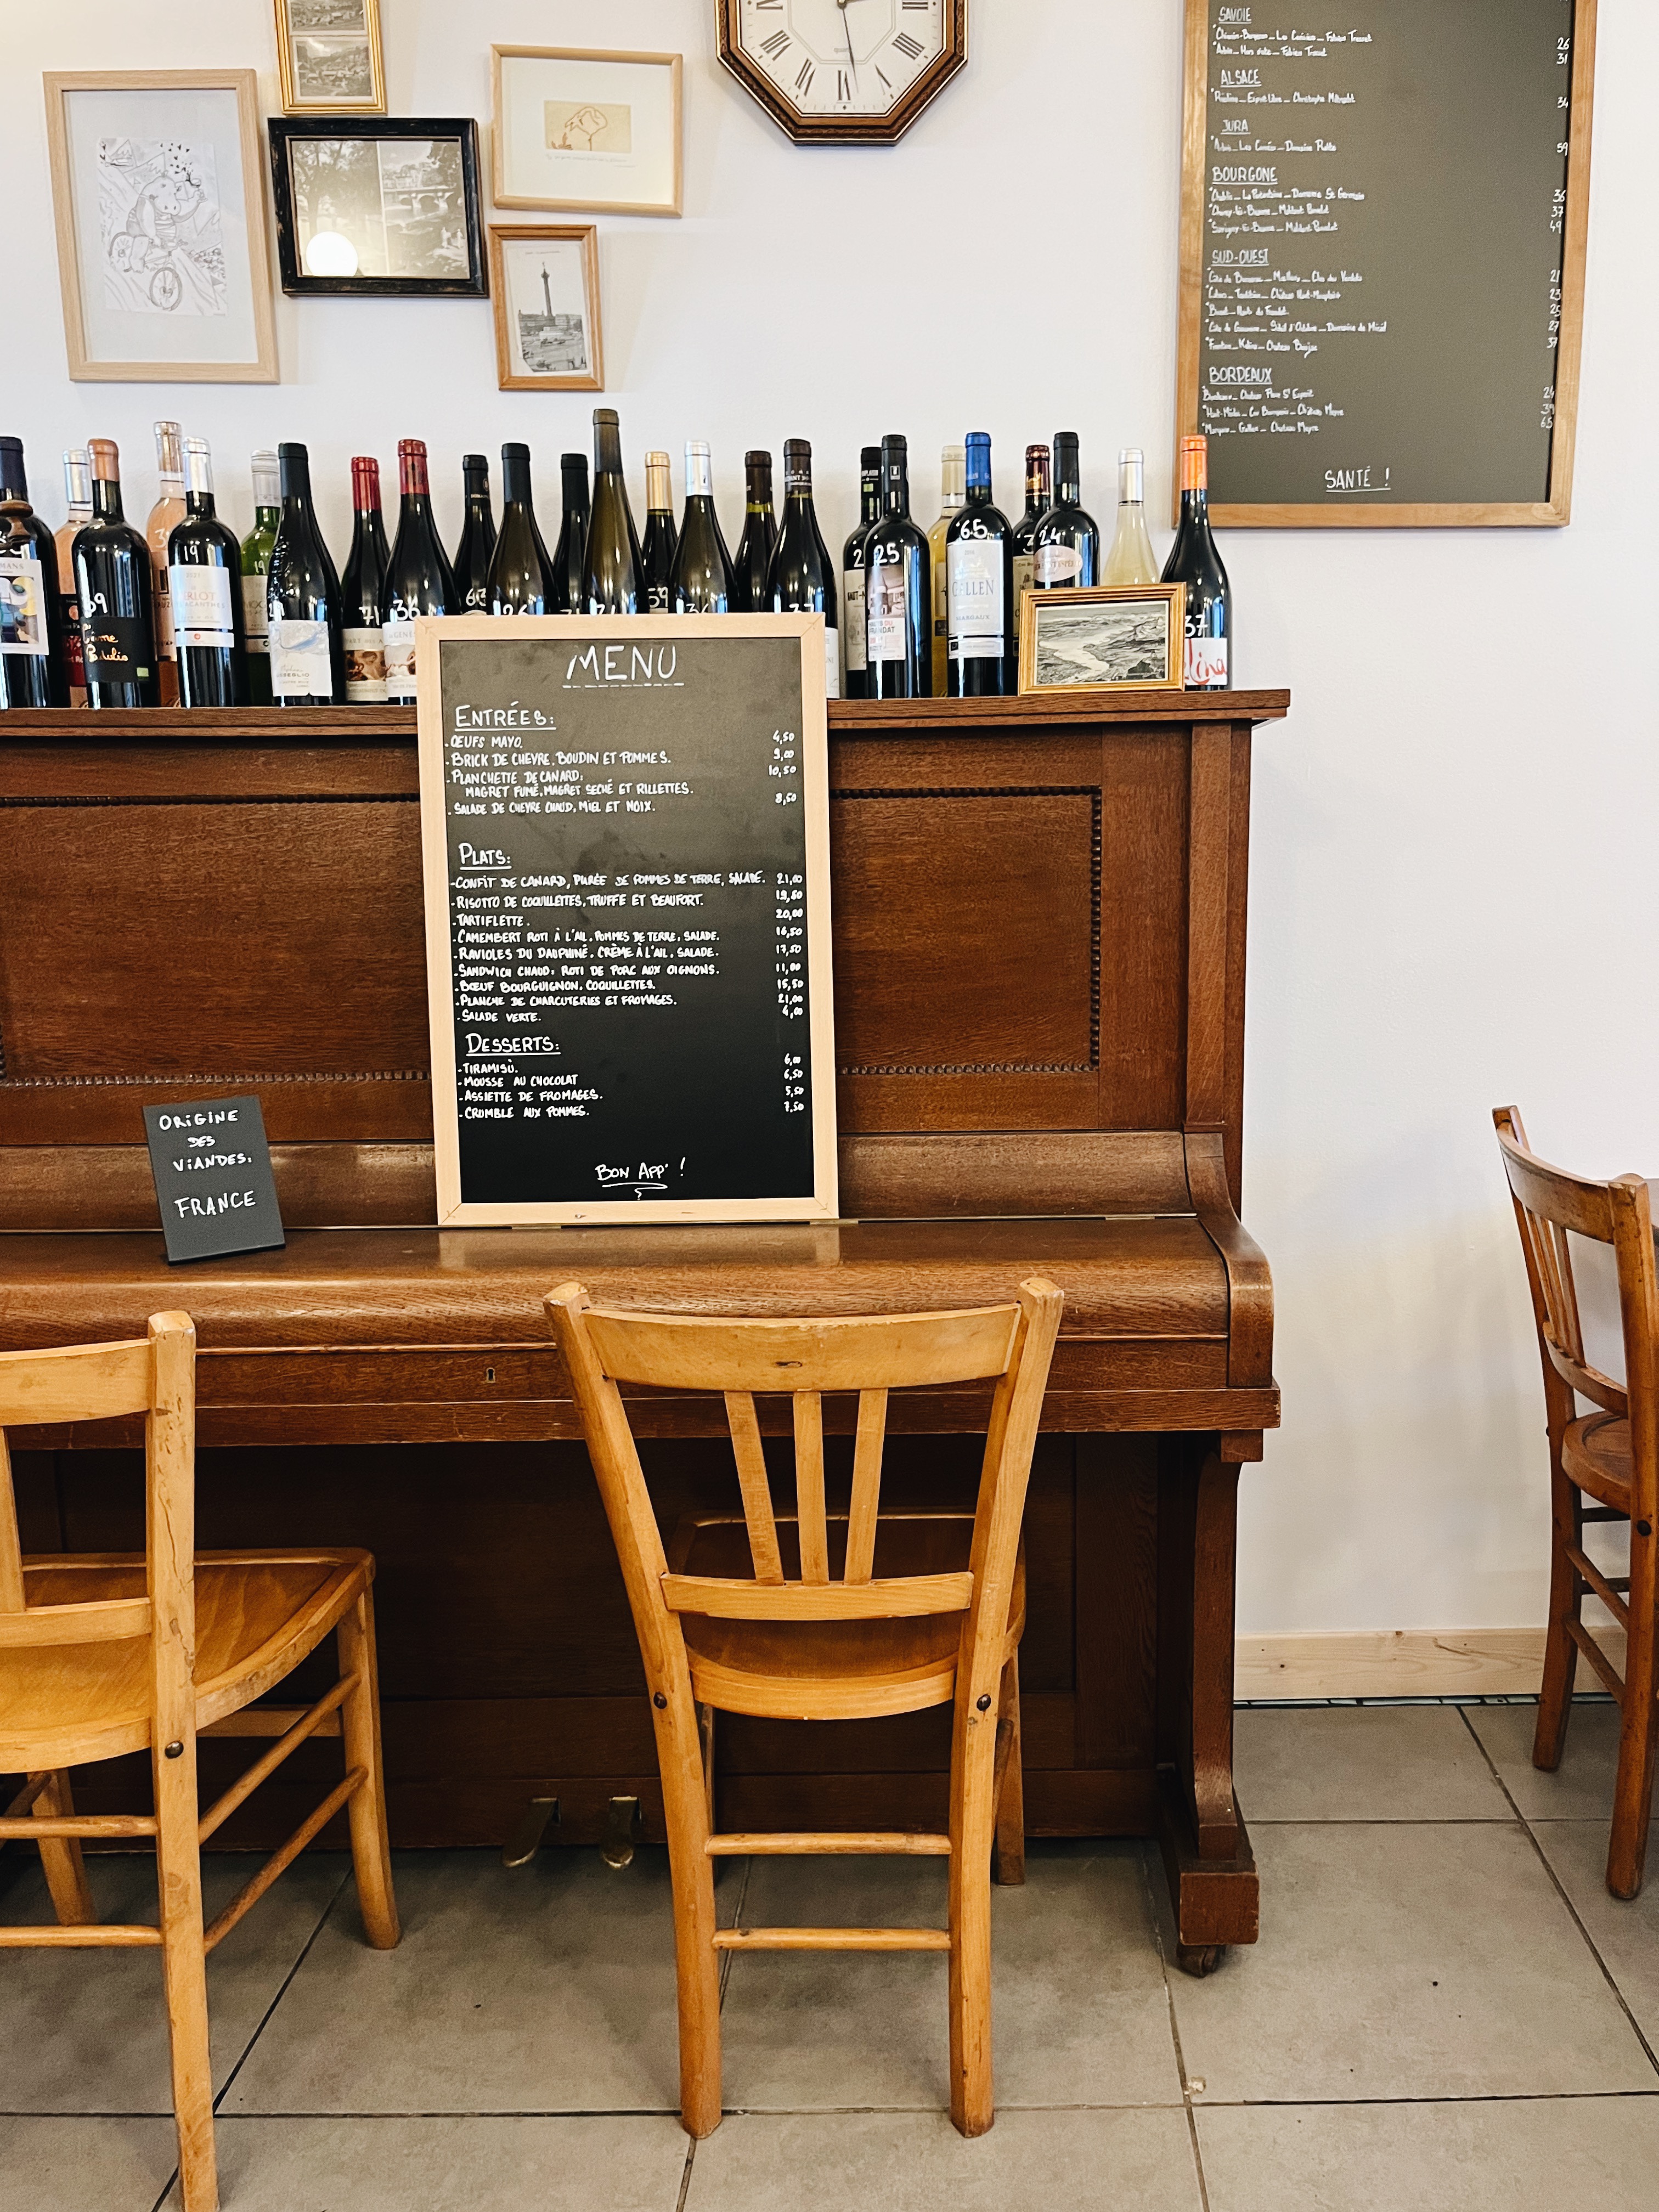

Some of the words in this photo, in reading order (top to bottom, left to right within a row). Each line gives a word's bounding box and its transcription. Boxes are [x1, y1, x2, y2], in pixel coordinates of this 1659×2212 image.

[1218, 7, 1252, 21] SAVOIE
[1556, 37, 1570, 50] 26
[1556, 53, 1568, 65] 31
[1221, 69, 1261, 84] ALSACE
[1557, 97, 1568, 109] 34
[1222, 119, 1249, 132] JURA
[1557, 142, 1568, 156] 59
[1212, 167, 1278, 182] BOURGONE
[1553, 189, 1566, 202] 36
[1551, 206, 1564, 218] 37
[1549, 220, 1562, 234] 49
[1212, 249, 1269, 264] SUD-OUEST
[1550, 269, 1560, 283] 21
[1549, 289, 1561, 301] 23
[1209, 367, 1272, 383] BORDEAUX
[1543, 385, 1555, 399] 24
[1541, 404, 1555, 415] 39
[1541, 417, 1553, 428] 65
[1324, 466, 1370, 489] SANTÉ
[1384, 467, 1390, 487] !
[960, 519, 988, 539] 65
[1039, 527, 1062, 545] 24
[184, 545, 199, 564] 19
[873, 543, 900, 564] 25
[255, 560, 266, 575] 19
[175, 591, 216, 601] ERLOT
[466, 588, 486, 606] 63
[648, 587, 669, 607] 59
[359, 605, 380, 626] 71
[393, 600, 421, 621] 36
[1184, 614, 1208, 638] 37
[566, 645, 676, 681] MENU
[455, 701, 554, 727] ENTRÉES:
[492, 736, 523, 749] MAYO.
[773, 730, 795, 744] 4,50
[451, 752, 489, 768] BRICK
[492, 753, 509, 767] DE
[555, 751, 599, 765] BOUDIN
[603, 752, 617, 765] ET
[774, 748, 794, 762] 9,00
[451, 769, 518, 785] PLANCHETTE
[524, 771, 538, 784] DE
[769, 765, 797, 778] 10,50
[465, 786, 510, 798] MAGRET
[543, 783, 581, 796] MAGRET
[618, 783, 633, 795] ET
[636, 782, 694, 795] RILLETTES.
[454, 802, 487, 815] SALADE
[491, 802, 505, 815] DE
[509, 802, 541, 814] CHEVRE
[605, 800, 620, 813] ET
[626, 800, 656, 813] NOIX.
[775, 793, 797, 806] 8,50
[458, 843, 511, 865] PLATS:
[500, 876, 517, 889] DE
[573, 873, 607, 887] PURÉE
[633, 873, 672, 885] POMMES
[674, 873, 688, 885] DE
[776, 872, 803, 885] 21,00
[456, 895, 500, 909] RISOTTO
[503, 896, 517, 909] DE
[586, 894, 627, 906] TRUFFE
[631, 894, 646, 906] ET
[650, 893, 703, 906] BEAUFORT.
[776, 889, 803, 903] 19,50
[776, 908, 803, 921] 20,00
[458, 929, 521, 943] CAMEMBERT
[527, 932, 548, 943] ROTI
[594, 930, 630, 943] POMMES
[633, 931, 646, 943] DE
[684, 930, 720, 941] SALADE.
[776, 926, 803, 939] 16,50
[458, 947, 512, 960] RAVIOLES
[516, 948, 533, 960] DU
[597, 943, 634, 959] CRÈME
[676, 947, 719, 958] SALADE.
[776, 944, 802, 957] 17,50
[458, 963, 512, 978] SANDWICH
[561, 965, 584, 977] ROTI
[589, 966, 604, 977] DE
[610, 964, 636, 976] PORC
[641, 965, 661, 975] AUX
[666, 963, 720, 975] OIGNONS.
[776, 962, 801, 975] 11,00
[585, 979, 656, 991] COQUILLETTES.
[777, 978, 804, 991] 15,50
[460, 994, 505, 1007] PLANCHE
[510, 996, 526, 1007] DE
[529, 995, 601, 1007] CHARCUTERIES
[605, 995, 618, 1006] ET
[620, 994, 678, 1006] FROMAGES.
[778, 993, 803, 1006] 21,00
[462, 1009, 498, 1023] SALADE
[505, 1012, 541, 1023] VERTE.
[782, 1005, 803, 1019] 4,00
[465, 1032, 560, 1053] DESSERTS:
[784, 1053, 801, 1066] 6,00
[464, 1076, 504, 1087] MOUSSE
[514, 1076, 526, 1086] AU
[531, 1074, 578, 1086] CHOCOLAT
[783, 1069, 803, 1081] 6,50
[465, 1090, 513, 1102] ASSIETTE
[518, 1091, 534, 1102] DE
[539, 1088, 603, 1102] FROMAGES.
[785, 1086, 804, 1098] 5,50
[159, 1109, 238, 1131] ORIGINE
[465, 1106, 514, 1119] CRUMBLE
[523, 1107, 541, 1118] AUX
[187, 1135, 216, 1148] DES
[595, 1164, 629, 1181] BON
[680, 1156, 686, 1176] !
[174, 1190, 256, 1218] FRANCE
